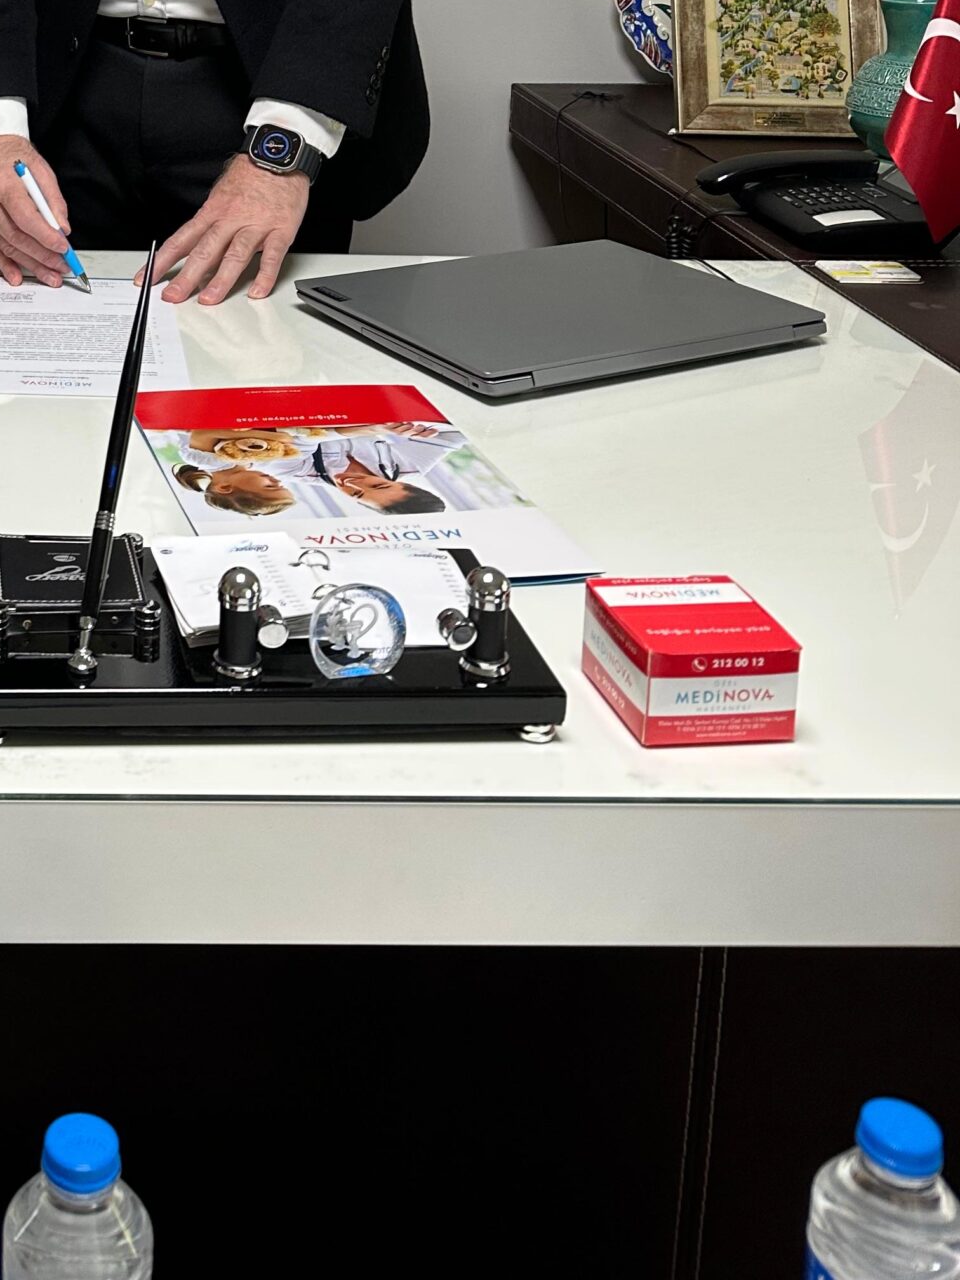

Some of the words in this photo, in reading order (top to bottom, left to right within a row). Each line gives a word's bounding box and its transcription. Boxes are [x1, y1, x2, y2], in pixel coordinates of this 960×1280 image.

[712, 658, 733, 668] 212
[734, 658, 749, 667] 00
[751, 657, 765, 666] 12
